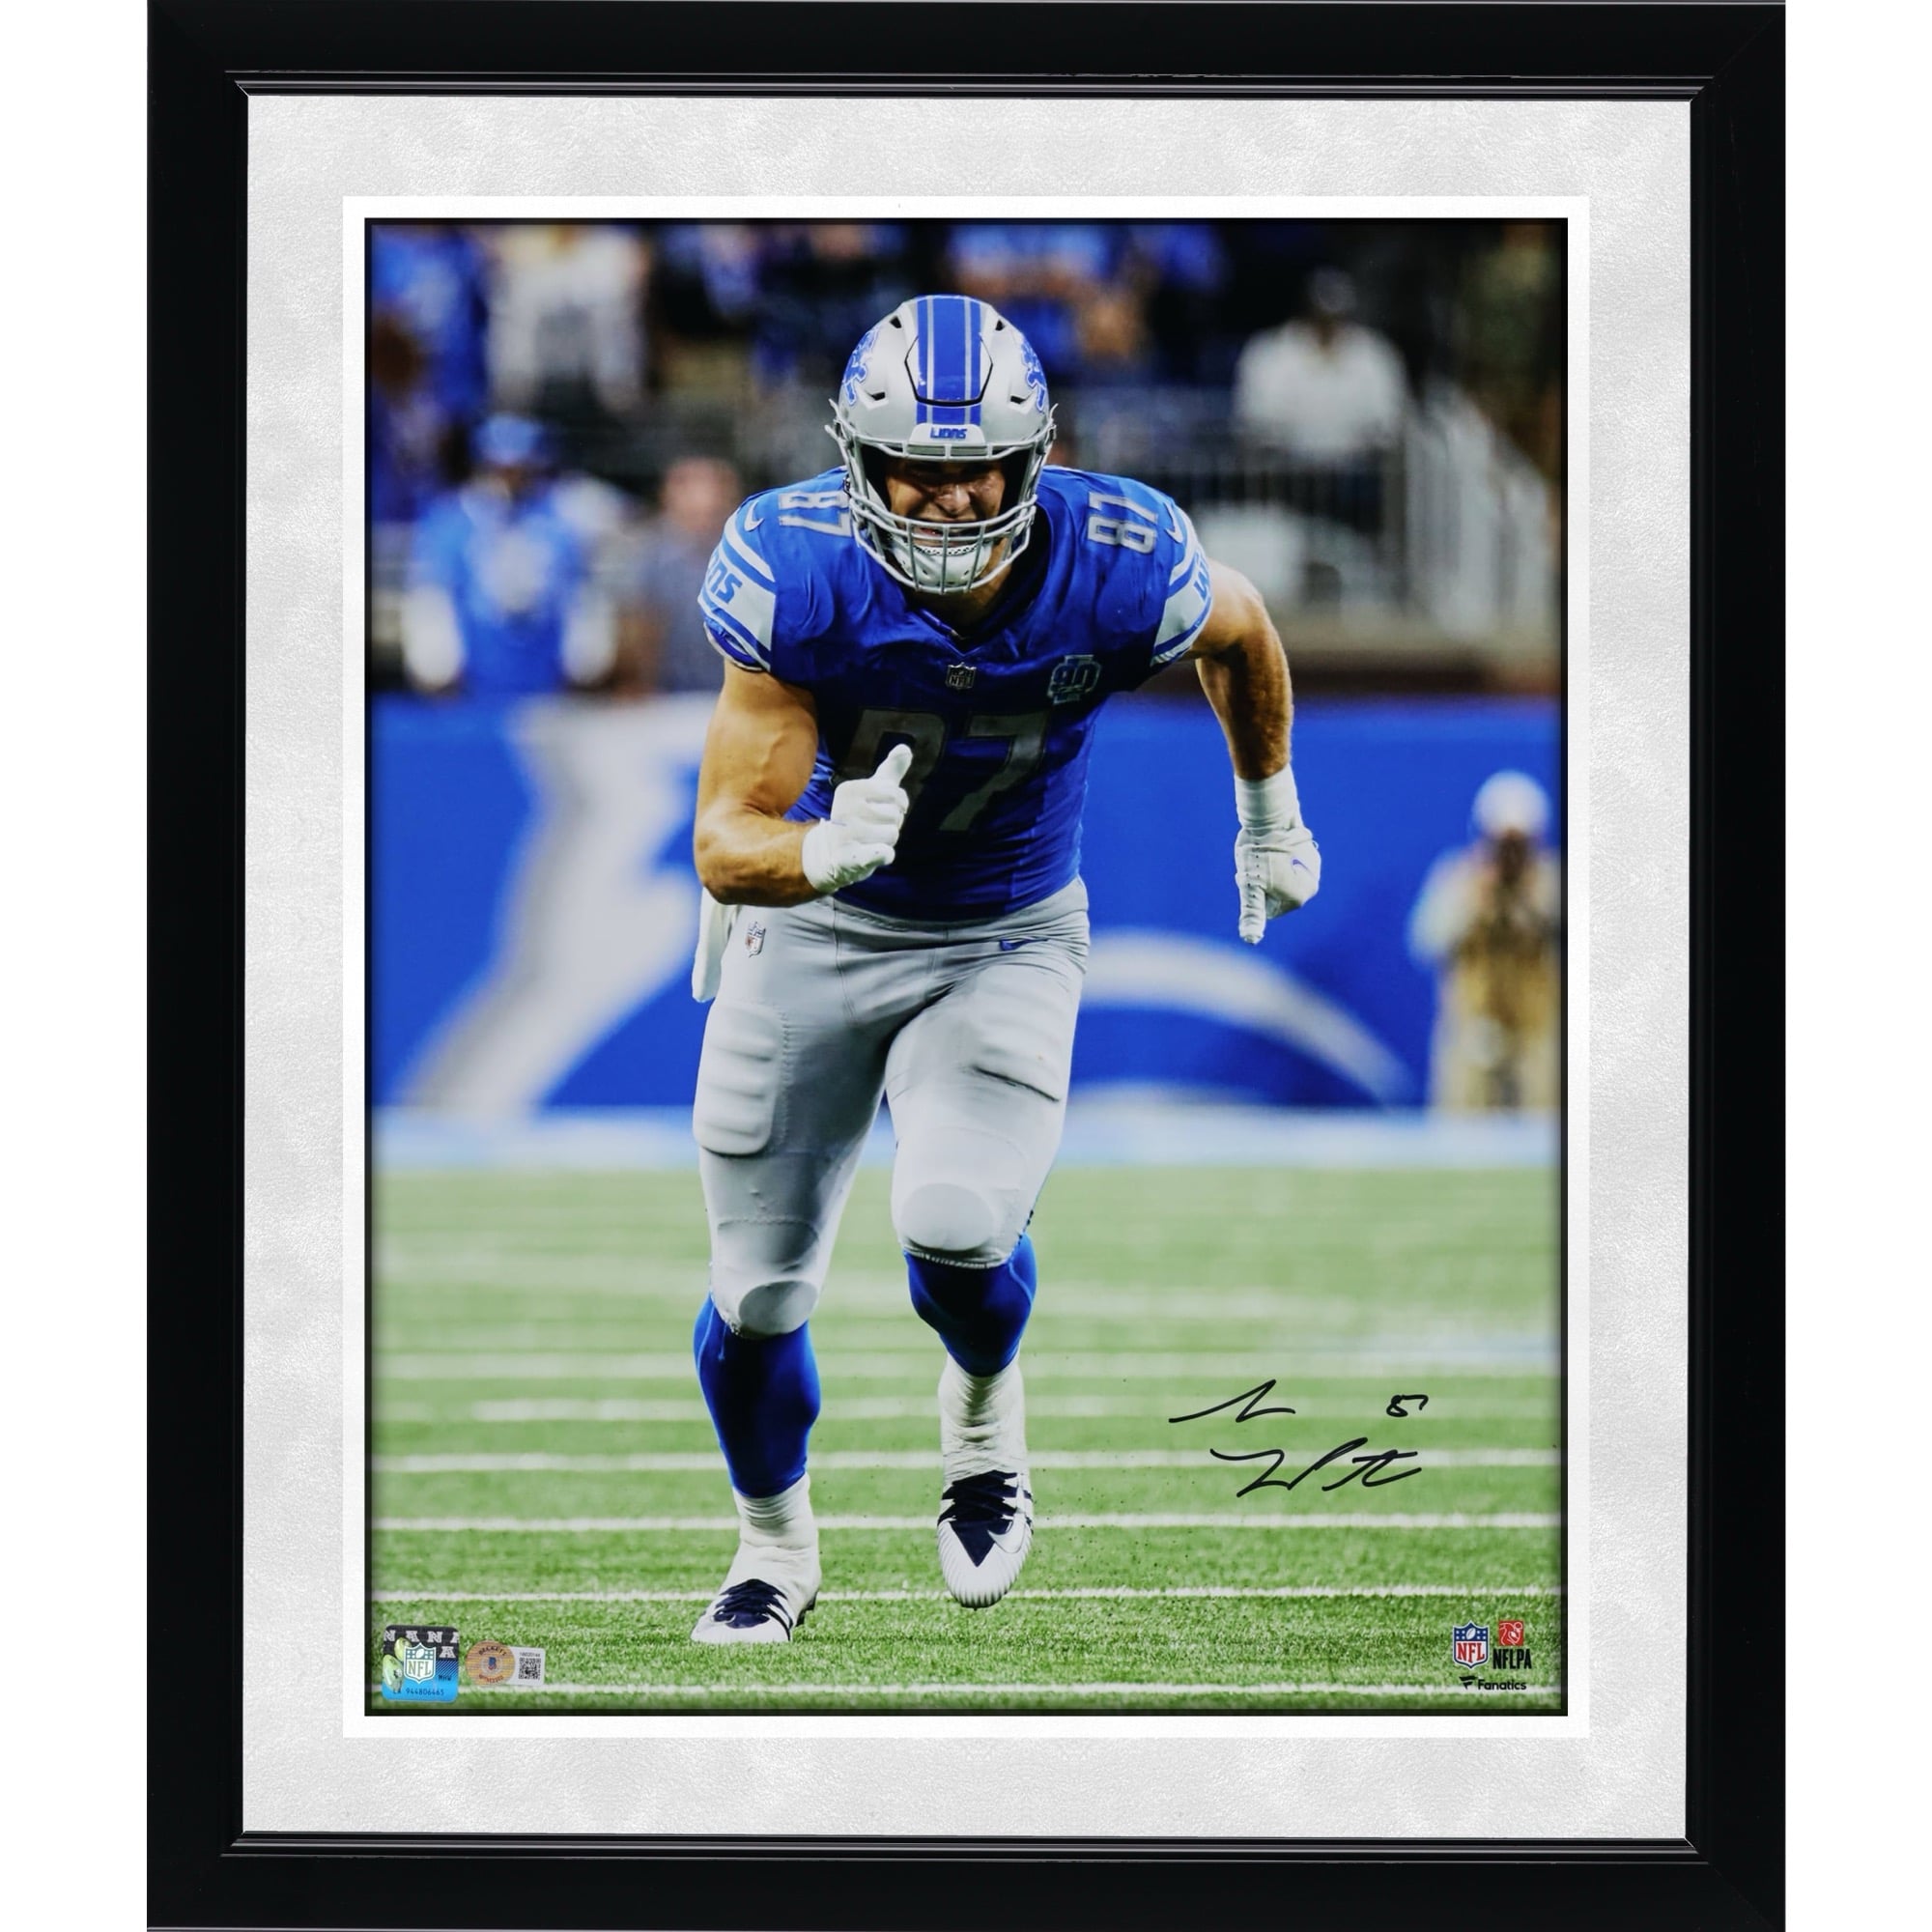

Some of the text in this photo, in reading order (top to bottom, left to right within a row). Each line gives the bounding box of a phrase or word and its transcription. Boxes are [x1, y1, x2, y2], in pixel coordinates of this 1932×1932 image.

[778, 490, 851, 537] 87
[1088, 491, 1158, 554] 87
[1457, 1642, 1485, 1662] NFL
[1492, 1648, 1532, 1670] NFLPA
[408, 1661, 432, 1677] NFL
[1477, 1678, 1527, 1690] Fanatics
